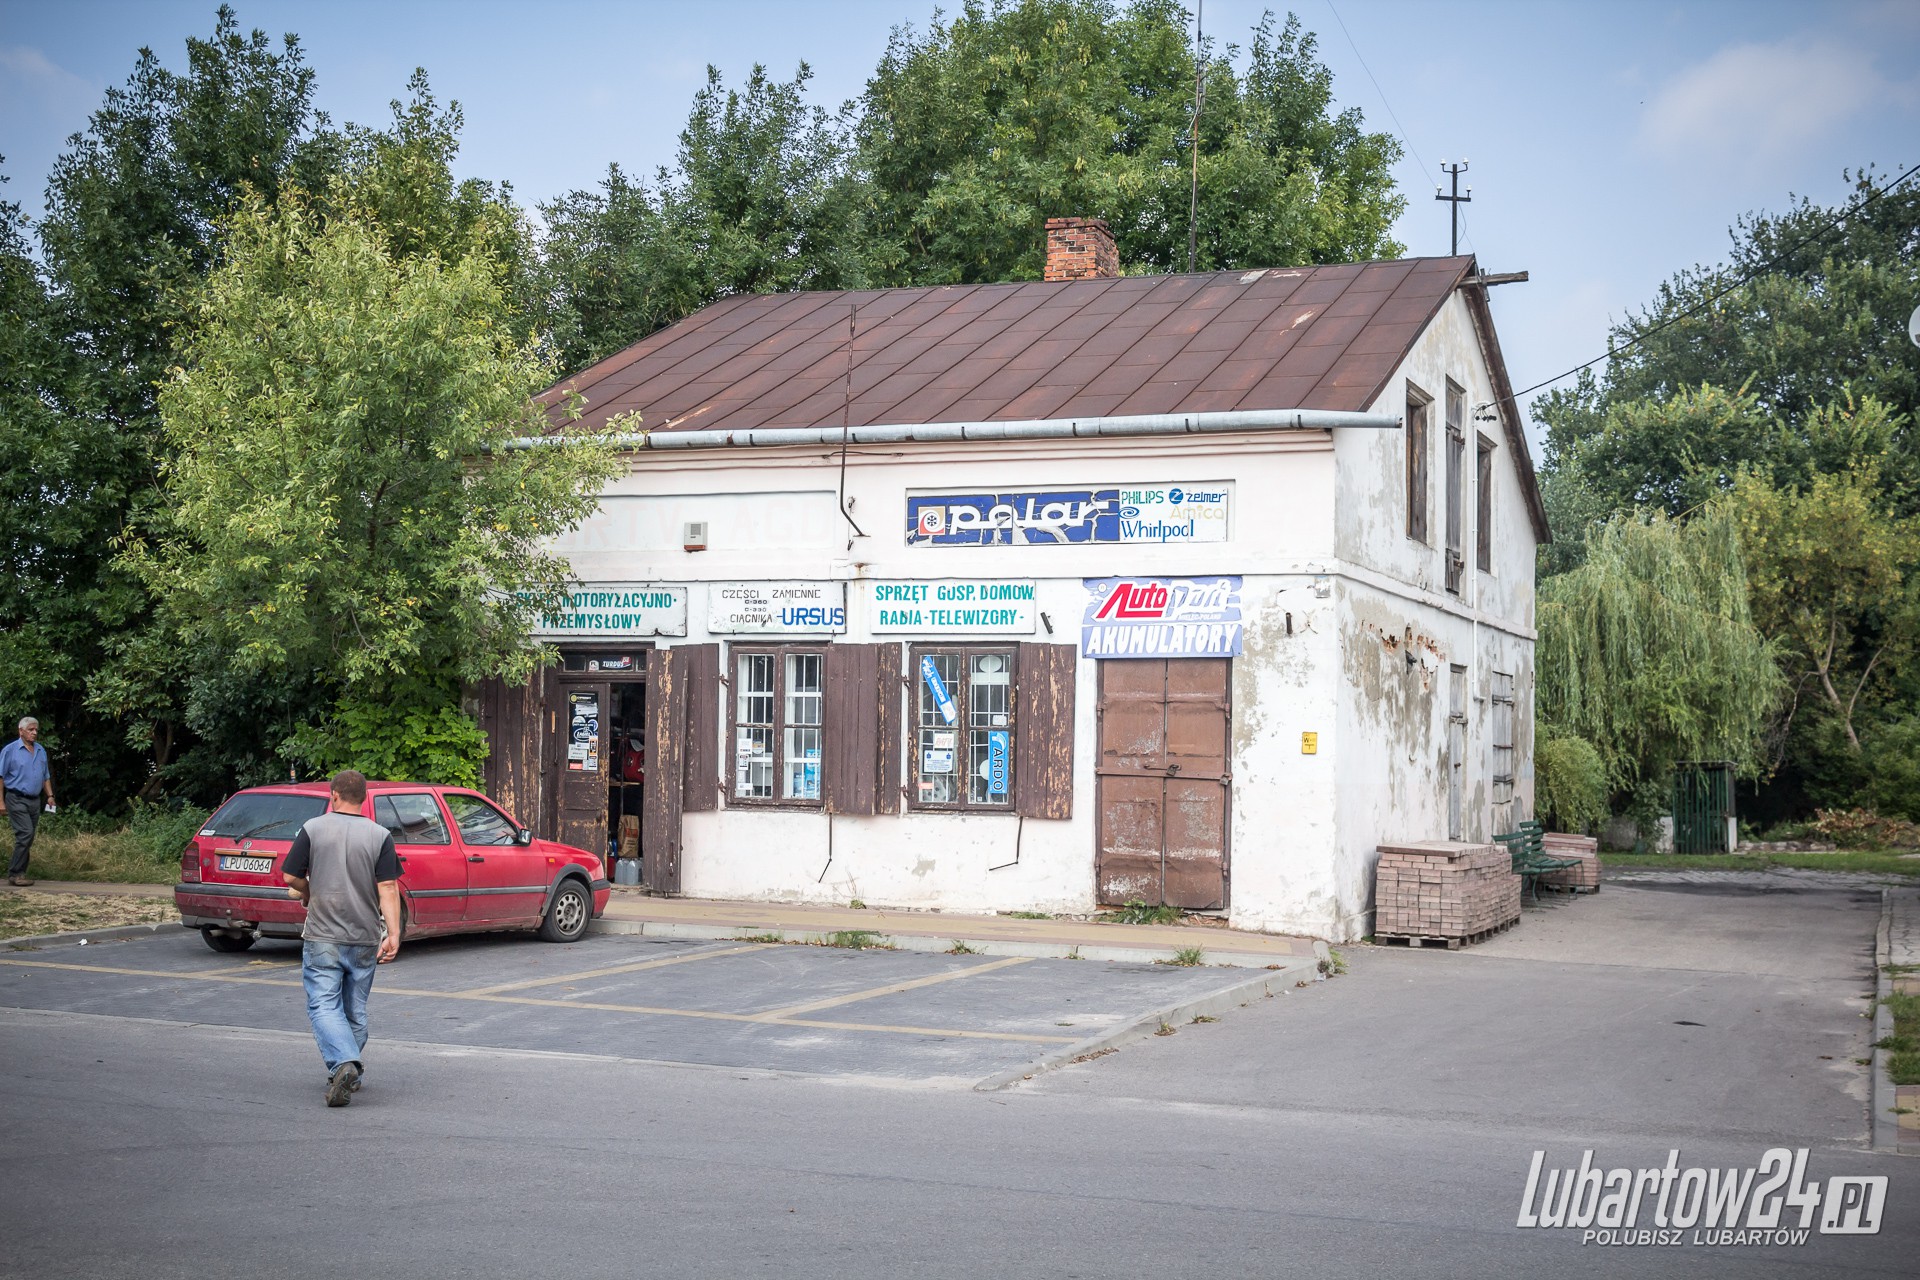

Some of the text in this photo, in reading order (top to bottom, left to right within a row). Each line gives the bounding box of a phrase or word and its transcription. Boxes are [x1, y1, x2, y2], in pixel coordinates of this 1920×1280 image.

[1121, 490, 1164, 505] PHILIPS
[949, 498, 1109, 535] polar
[1170, 505, 1225, 519] Amica
[1121, 519, 1194, 542] Whirlpool
[772, 589, 821, 598] ZAMIENNE
[875, 585, 929, 604] SPRZĘT
[782, 607, 844, 626] URSUS
[1086, 624, 1238, 654] AKUMULATORY
[993, 747, 1004, 791] ARDO
[224, 857, 270, 872] LPU 06064
